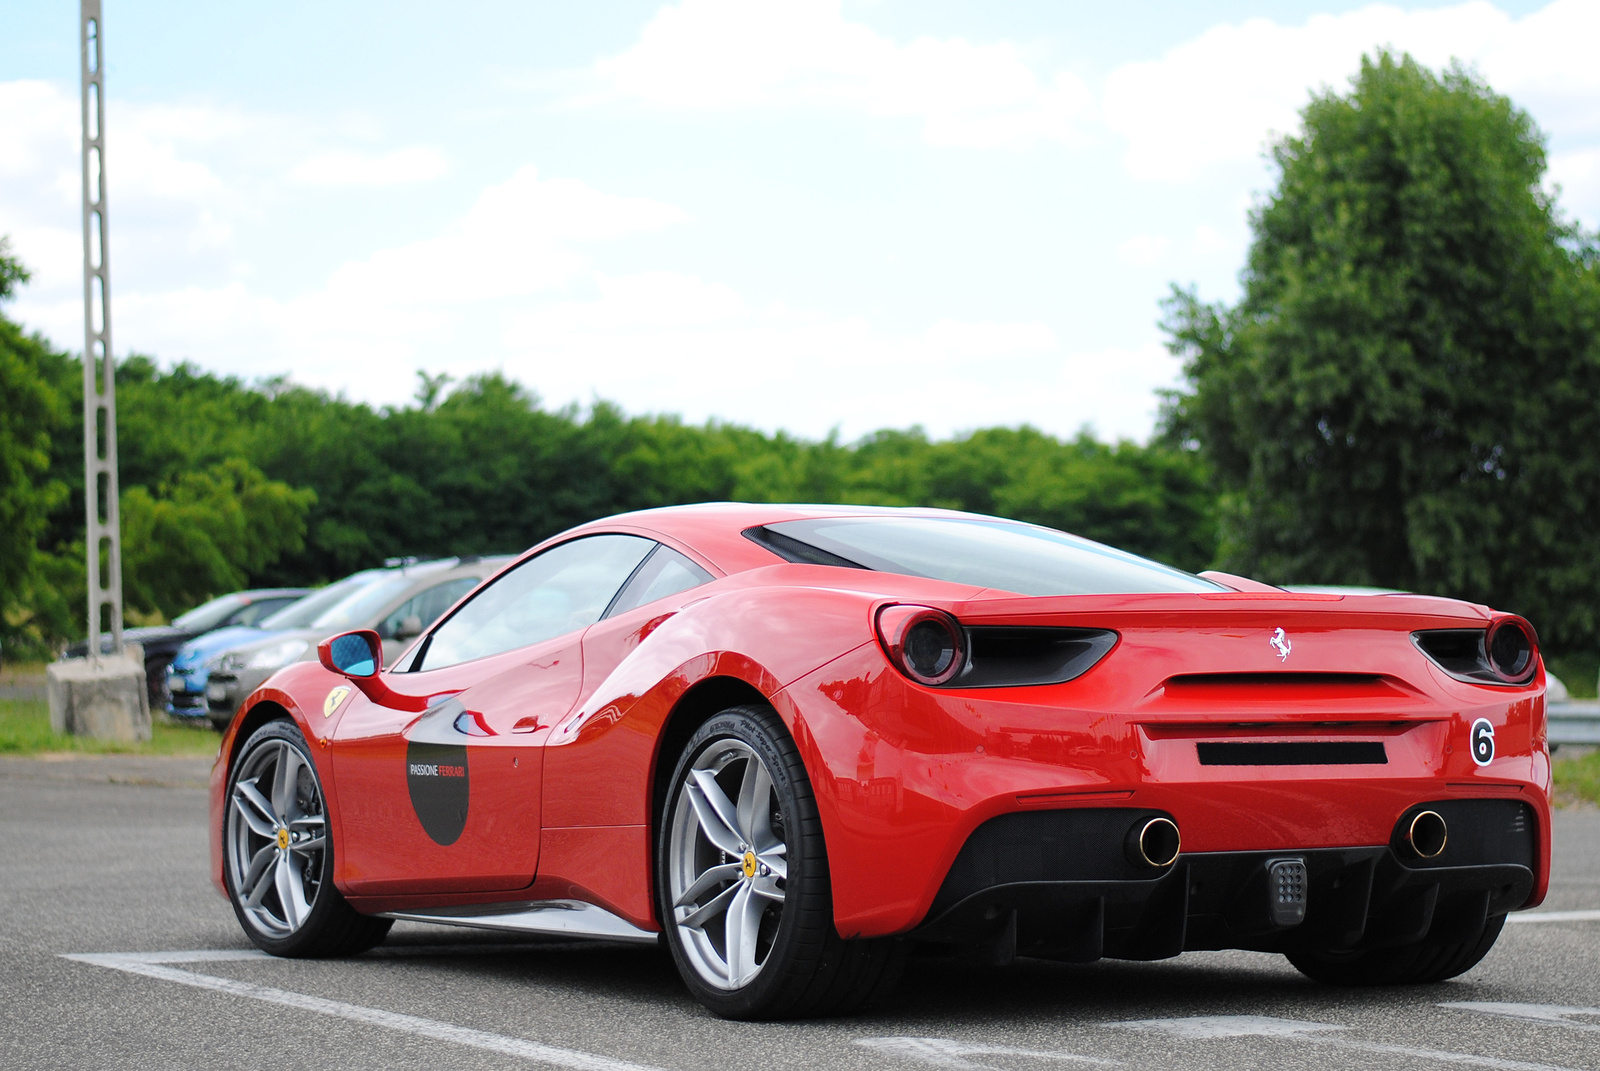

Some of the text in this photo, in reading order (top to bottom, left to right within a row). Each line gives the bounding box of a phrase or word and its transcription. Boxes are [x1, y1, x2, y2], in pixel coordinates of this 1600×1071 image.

[740, 719, 786, 782] Pilot Super Sport
[1471, 718, 1494, 766] 6
[410, 764, 465, 777] PASSIONE FERRARI
